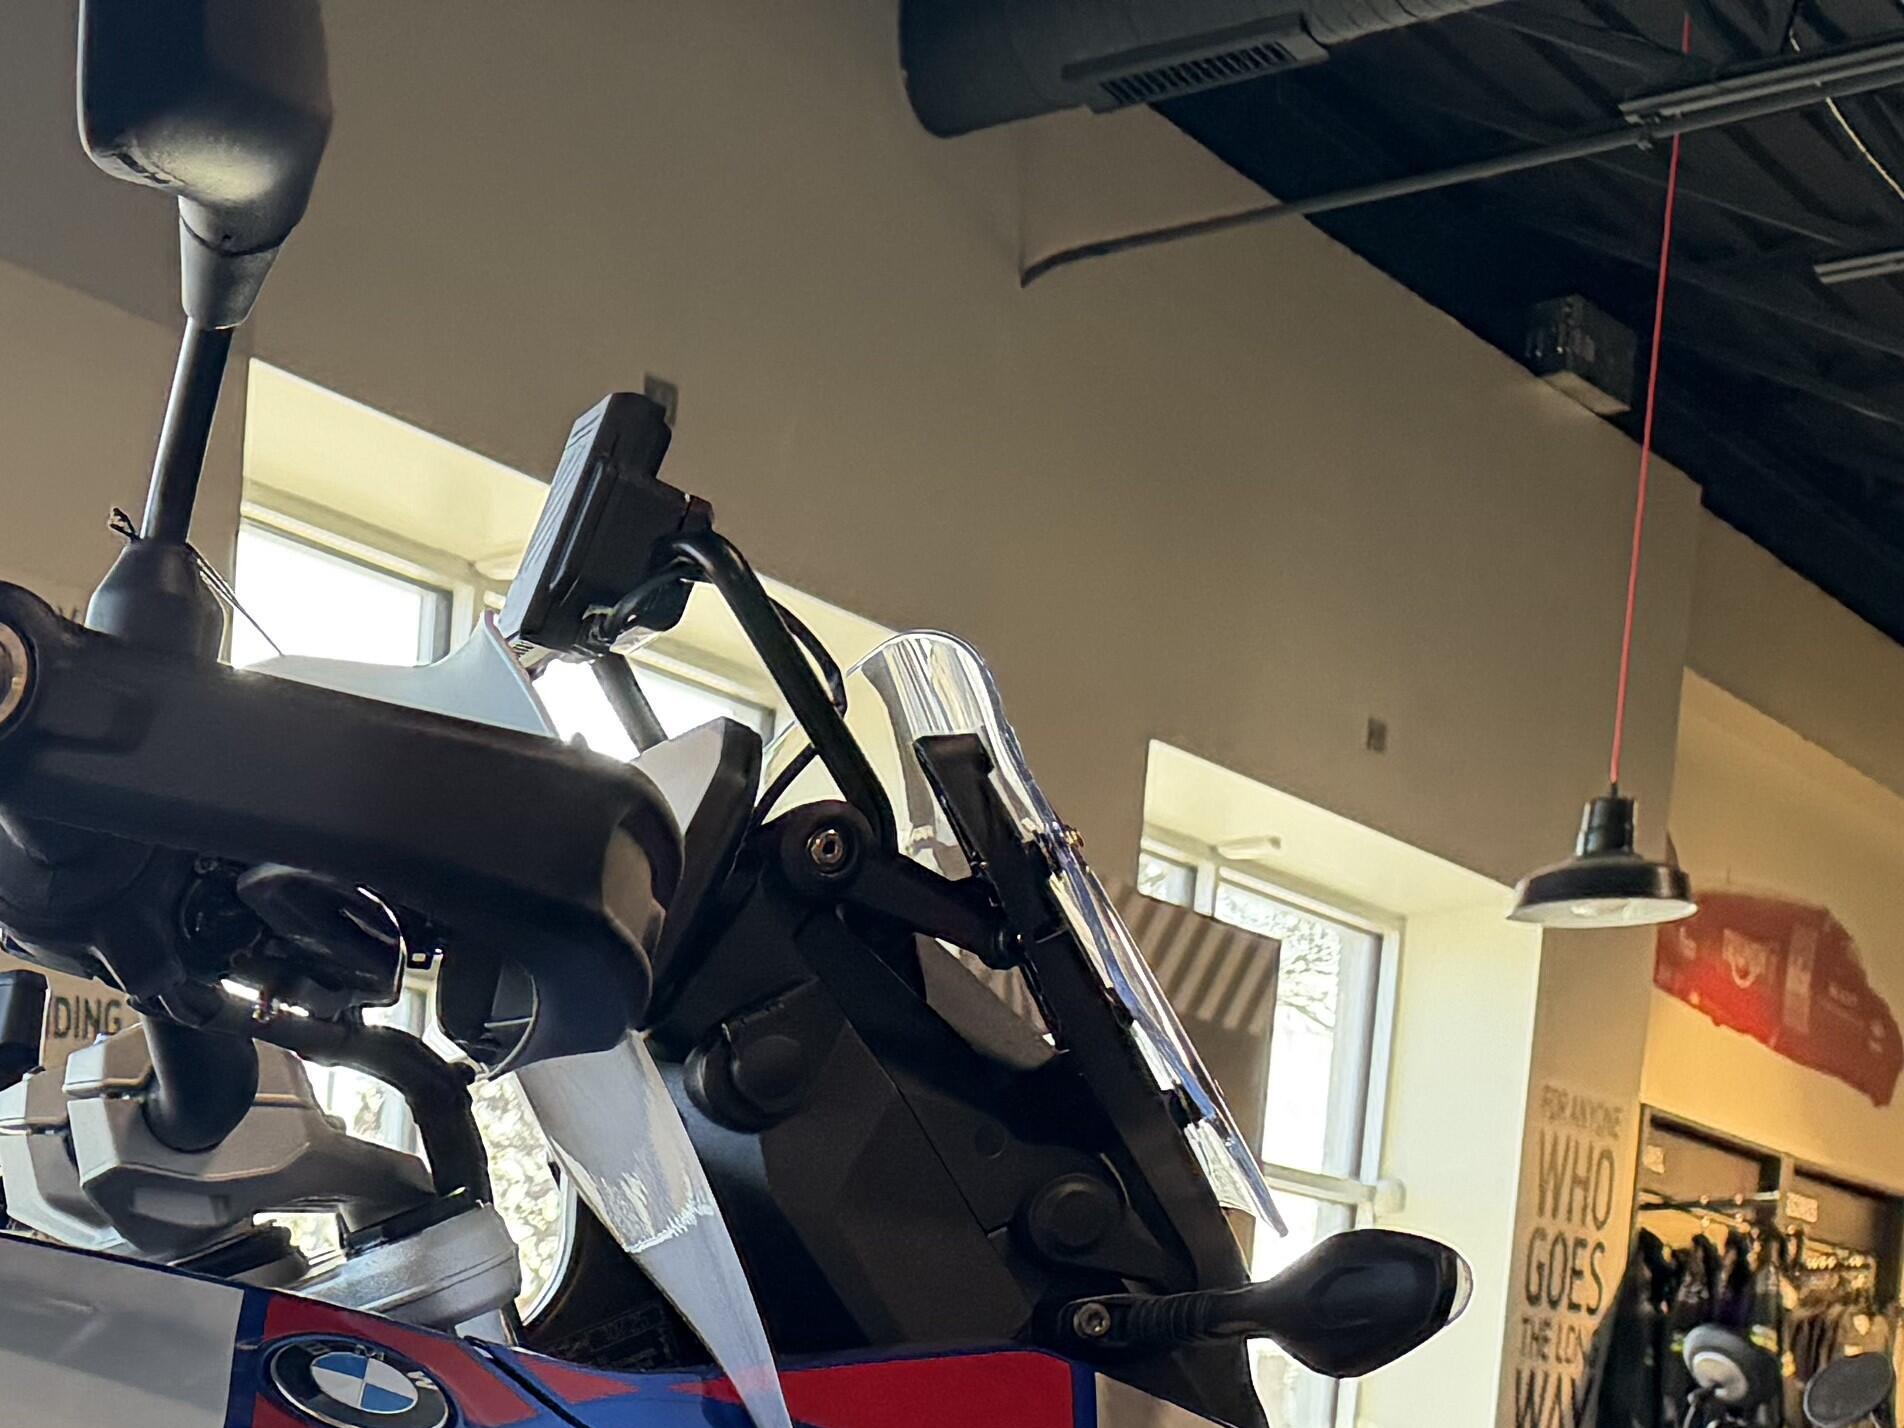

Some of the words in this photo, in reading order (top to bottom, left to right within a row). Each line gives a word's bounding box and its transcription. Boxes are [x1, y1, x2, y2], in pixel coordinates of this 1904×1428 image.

[1537, 1128, 1616, 1232] WHO
[1524, 1226, 1607, 1316] GOES
[1520, 1316, 1551, 1360] THE
